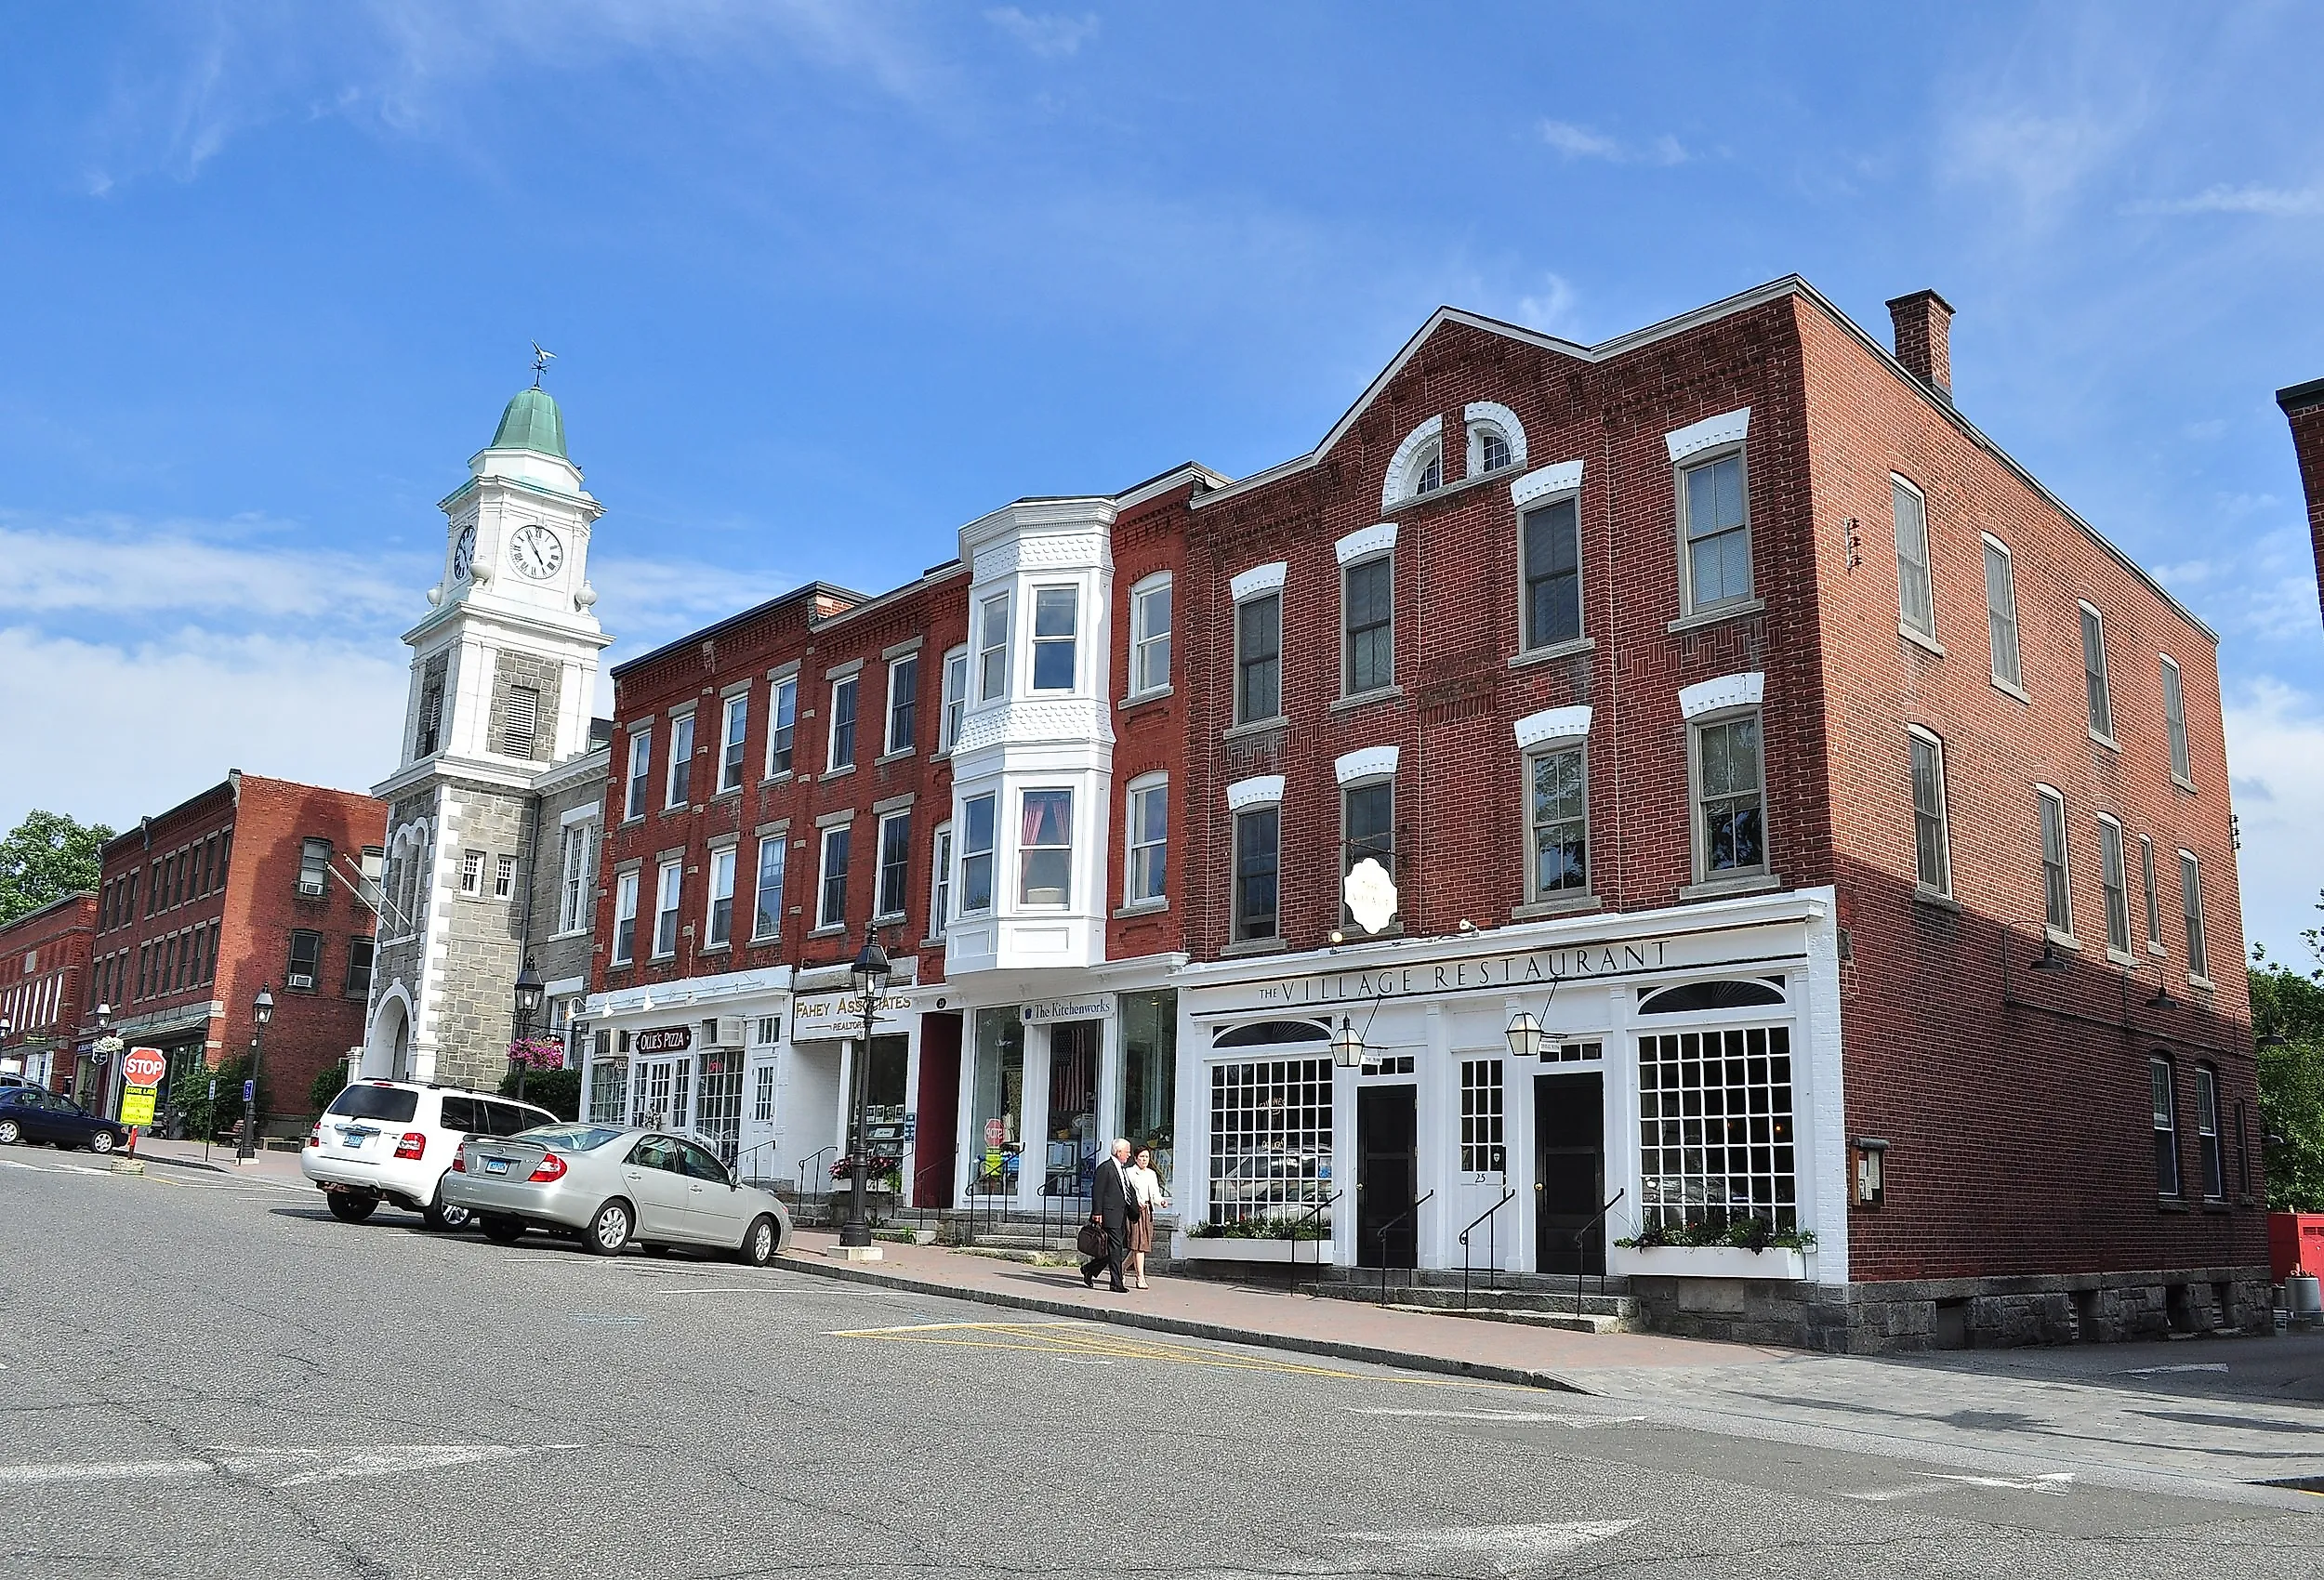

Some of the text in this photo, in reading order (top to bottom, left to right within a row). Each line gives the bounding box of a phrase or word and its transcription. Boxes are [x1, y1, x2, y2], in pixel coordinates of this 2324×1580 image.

[1260, 940, 1671, 1002] THE VILLAGE RESTAURANT
[796, 995, 911, 1019] FAHEY ASSIATES
[1035, 998, 1110, 1018] The Kitchenworks
[664, 1032, 683, 1047] PIZZA
[125, 1058, 163, 1075] STOP
[1474, 1173, 1486, 1183] 25
